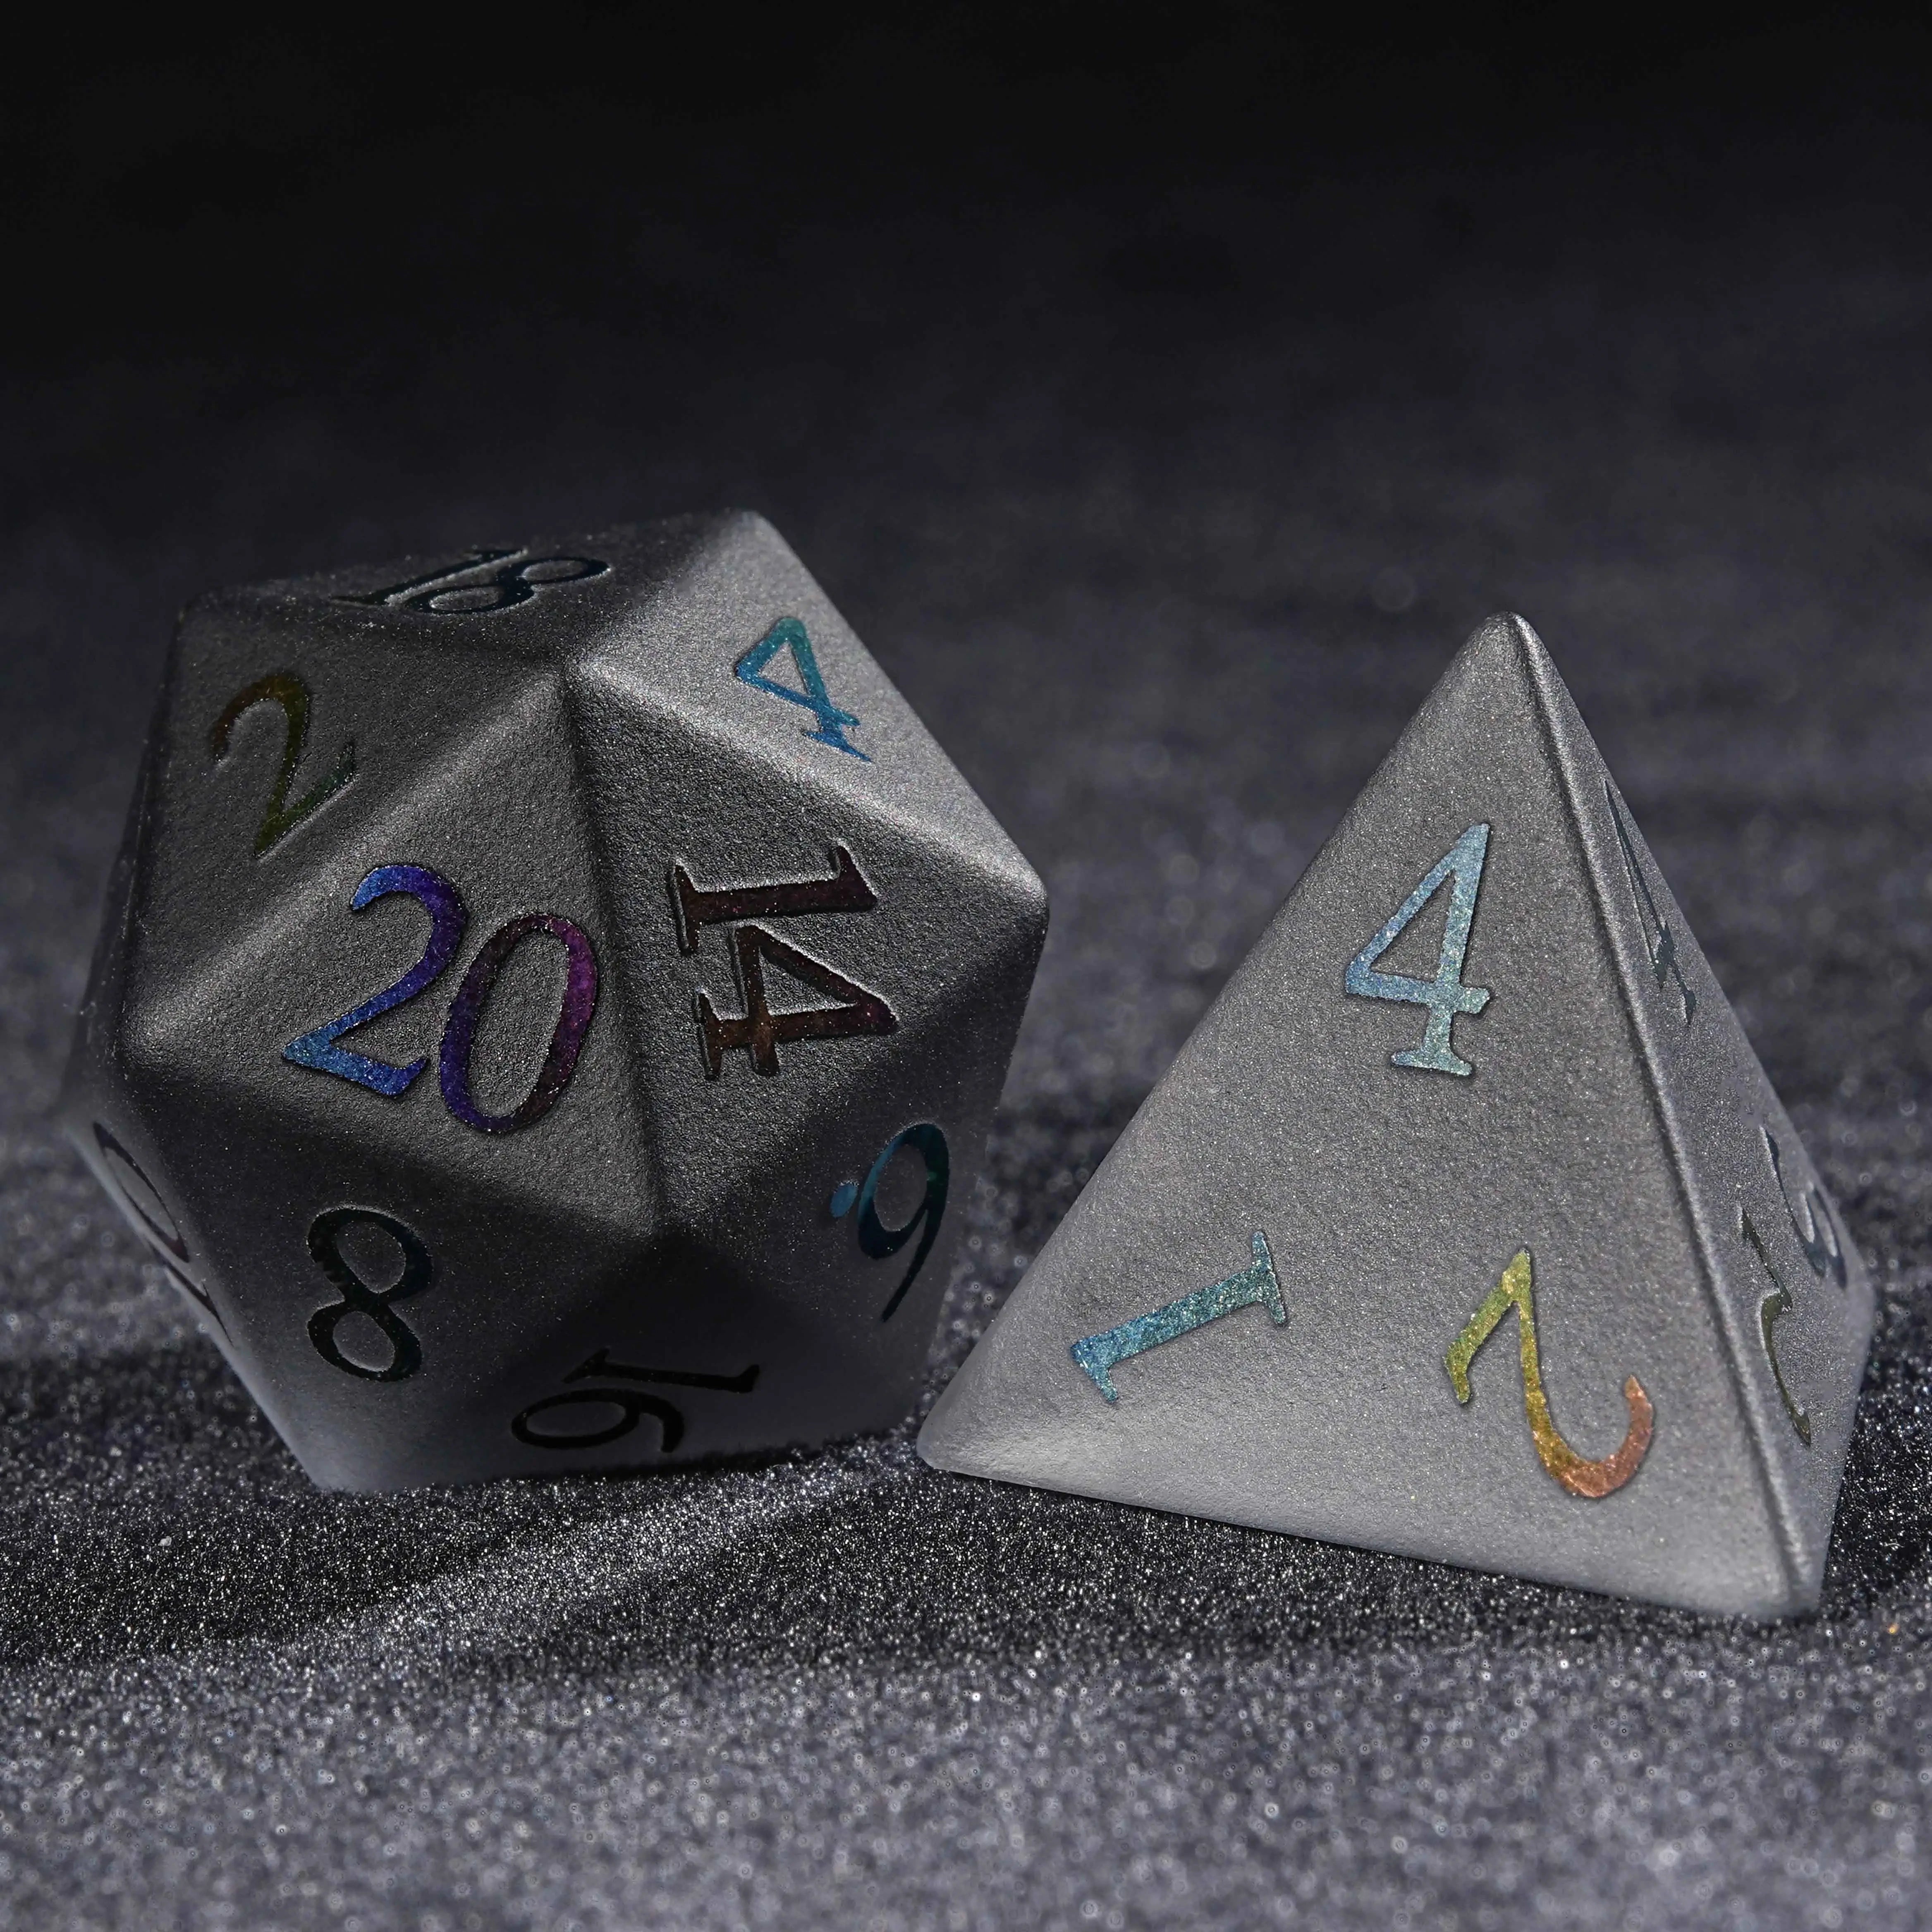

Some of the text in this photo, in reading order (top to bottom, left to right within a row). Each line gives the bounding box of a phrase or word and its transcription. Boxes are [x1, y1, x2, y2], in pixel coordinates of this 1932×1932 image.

[332, 549, 610, 615] 18
[213, 673, 355, 856] 2
[734, 616, 870, 762] 4
[281, 864, 599, 1135] 20
[674, 840, 901, 1081] 14
[1344, 822, 1490, 1075] 4
[306, 1205, 433, 1382] 8
[1070, 1231, 1287, 1402] 1
[1444, 1248, 1655, 1498] 2
[511, 1349, 761, 1454] 16
